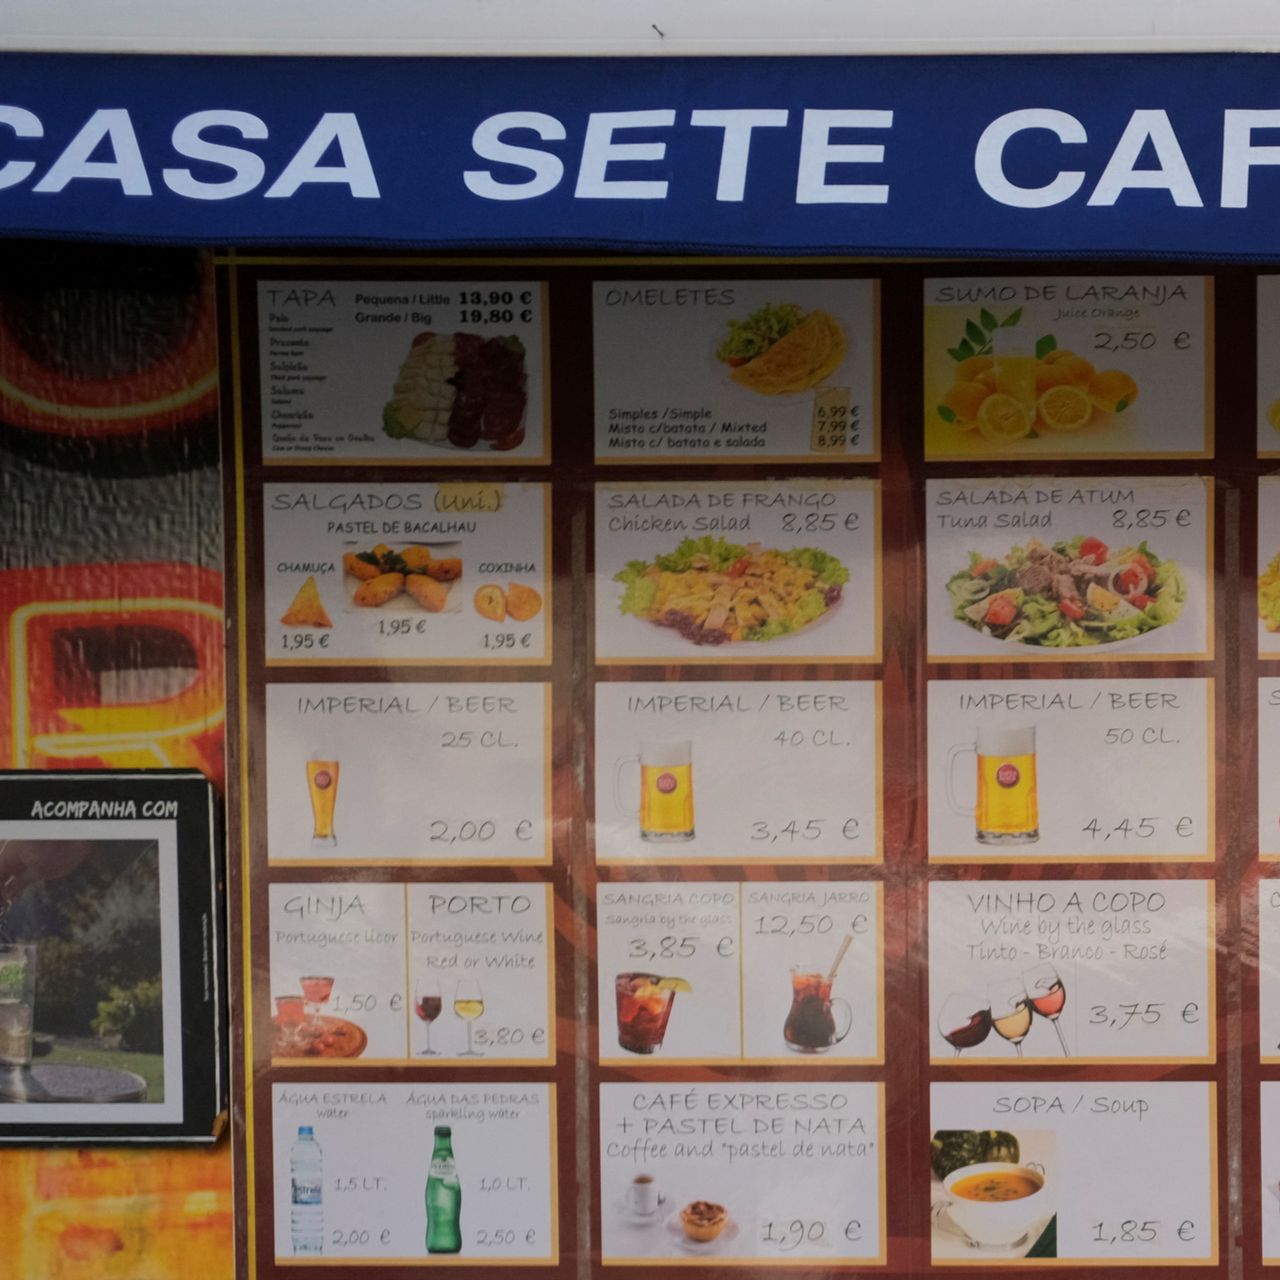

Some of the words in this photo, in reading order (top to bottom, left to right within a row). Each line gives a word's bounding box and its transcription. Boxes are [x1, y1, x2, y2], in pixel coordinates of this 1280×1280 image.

[463, 109, 893, 204] SETE
[266, 289, 336, 306] TAPA
[355, 294, 409, 306] Pequena
[460, 292, 513, 306] 13,90
[606, 288, 735, 306] OMELETES
[936, 287, 1016, 302] SUMO
[1066, 285, 1186, 306] LARANJA
[355, 312, 401, 323] Grande
[411, 312, 432, 325] Big
[461, 310, 513, 324] 19,80
[1094, 332, 1156, 352] 2,50
[609, 409, 658, 422] Simples
[818, 406, 846, 417] 6,99
[818, 421, 846, 432] 7,99
[818, 434, 846, 447] 8,99
[272, 493, 422, 513] SALGADOS
[608, 494, 700, 508] SALADA
[742, 493, 836, 509] FRANGO
[936, 490, 1028, 505] SALADA
[1068, 489, 1134, 504] ATUM
[328, 521, 378, 534] PASTEL
[404, 521, 476, 533] BACALHAU
[609, 514, 687, 532] Chicken
[692, 514, 750, 530] Salad
[782, 513, 837, 533] 8,85
[937, 508, 987, 528] Tuna
[995, 511, 1051, 528] Salad
[1113, 509, 1170, 529] 8,85
[277, 563, 335, 574] CHAMUÇA
[479, 563, 536, 573] COXINHA
[299, 695, 416, 714] IMPERIAL
[446, 696, 517, 713] BEER
[629, 695, 748, 712] IMPERIAL
[776, 695, 847, 711] BEER
[960, 693, 1081, 710] IMPERIAL
[1108, 693, 1179, 709] BEER
[31, 800, 136, 819] ACOMPANHA
[143, 801, 177, 817] COM
[430, 820, 495, 844] 2,00
[751, 820, 824, 843] 3,45
[1082, 818, 1154, 841] 4,45
[284, 896, 364, 920] GINJA
[429, 895, 531, 913] PORTO
[602, 892, 684, 906] SANGRIA
[748, 892, 816, 904] SANGRIA
[968, 892, 1055, 913] VINHO
[1093, 892, 1165, 912] COPO
[981, 915, 1031, 935] Wine
[629, 936, 696, 960] 3,85
[755, 915, 833, 937] 12,50
[967, 941, 1016, 960] Tinto
[1036, 944, 1103, 960] Branco
[1124, 940, 1166, 960] Rosé
[1089, 1003, 1163, 1030] 3,75
[323, 1093, 386, 1104] ESTRELA
[483, 1093, 539, 1104] PEDRAS
[633, 1088, 696, 1110] CAFÉ
[708, 1093, 847, 1110] EXPRESSO
[993, 1096, 1064, 1113] SOPA
[1091, 1097, 1148, 1121] Soup
[643, 1118, 745, 1134] PASTEL
[795, 1118, 865, 1134] NATA
[607, 1138, 667, 1163] Coffee
[763, 1220, 824, 1247] 1,90
[1093, 1220, 1158, 1244] 1,85
